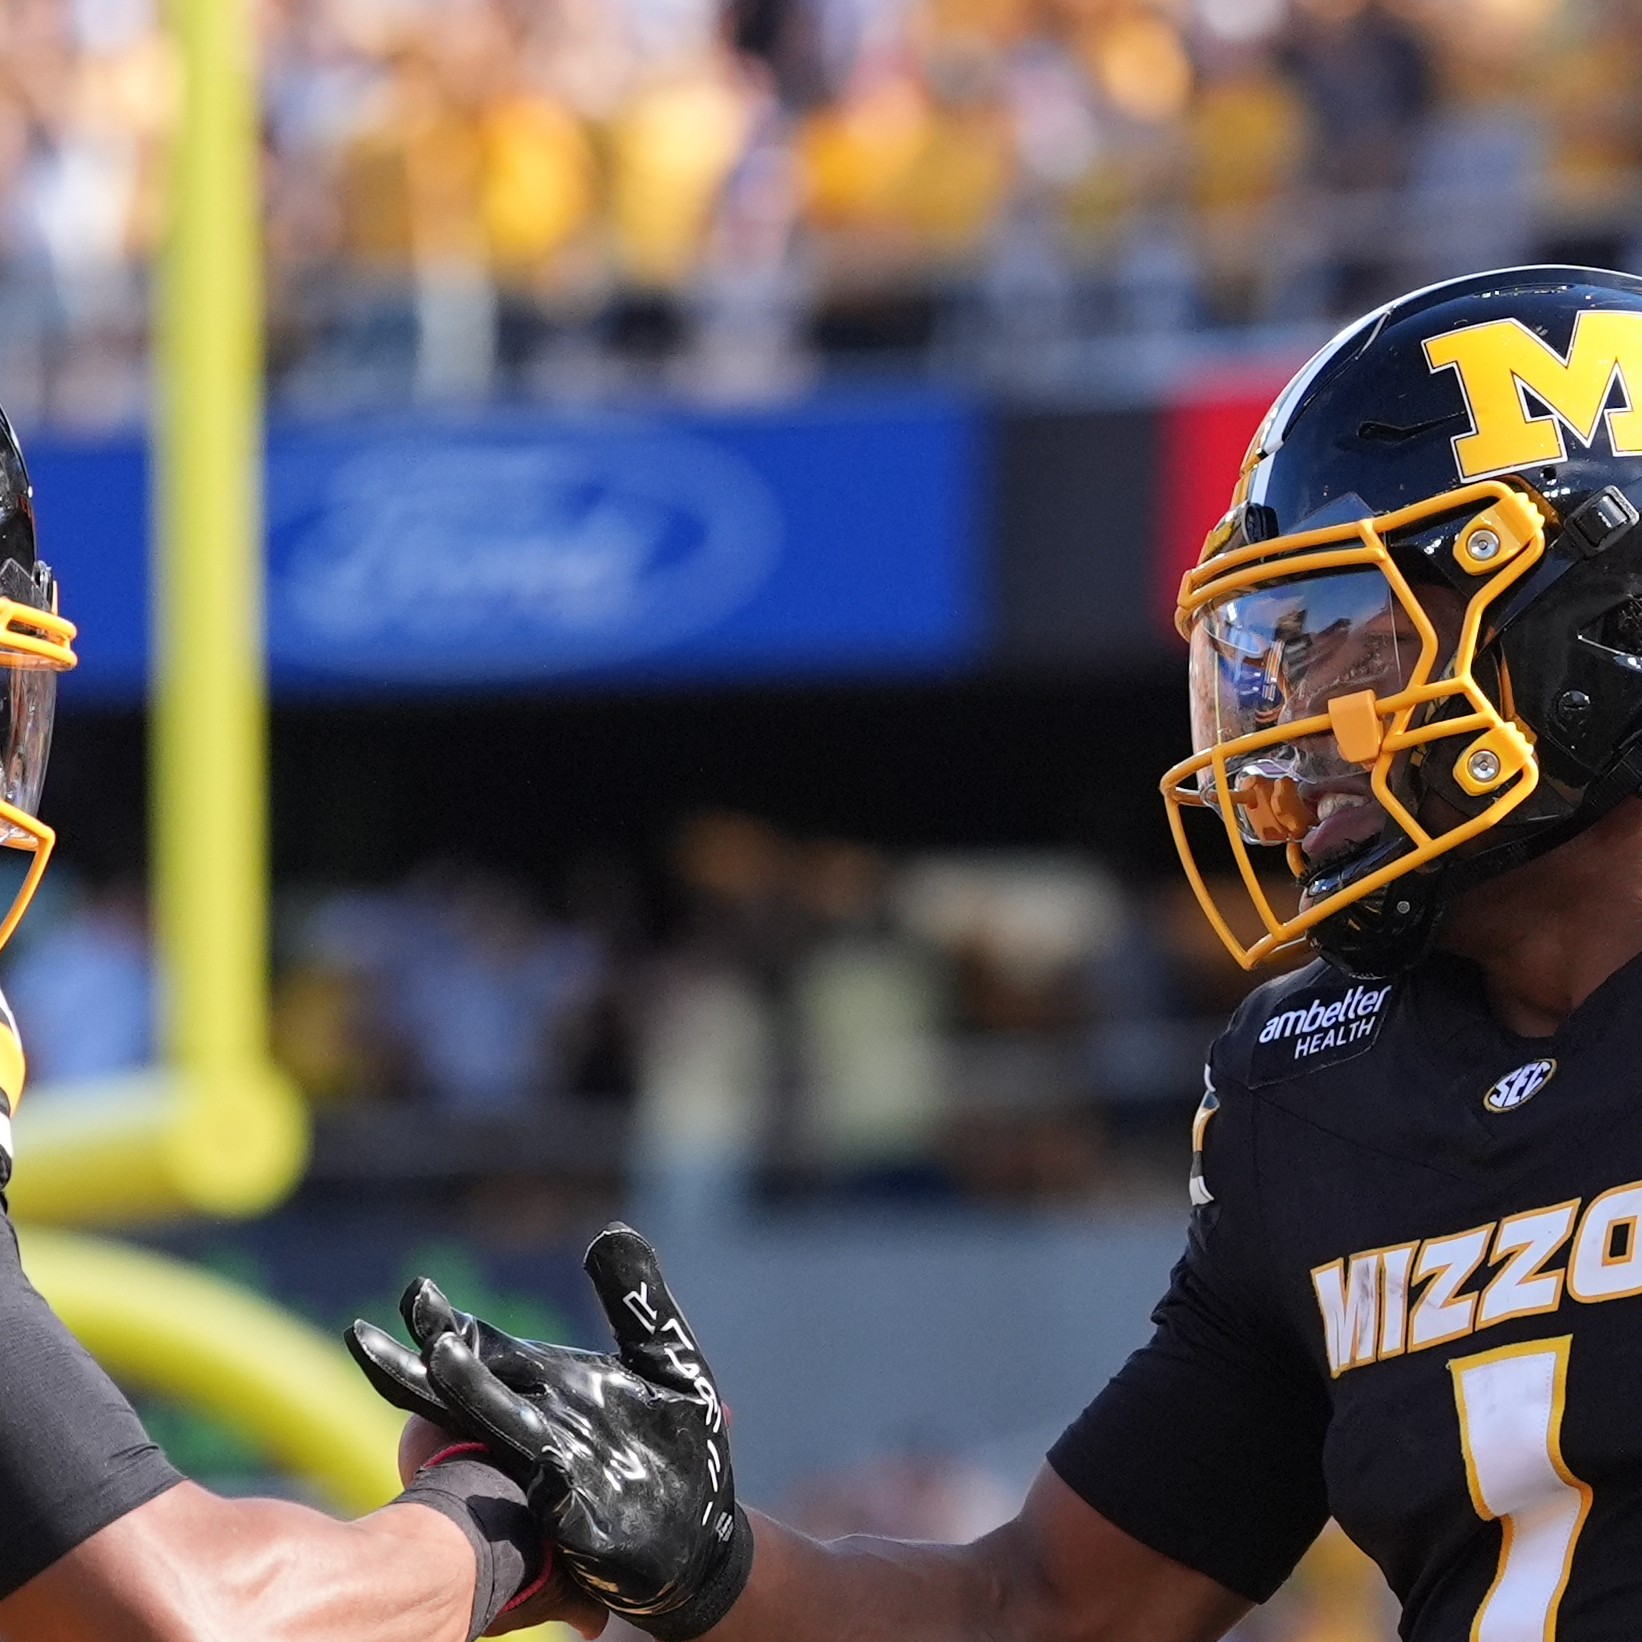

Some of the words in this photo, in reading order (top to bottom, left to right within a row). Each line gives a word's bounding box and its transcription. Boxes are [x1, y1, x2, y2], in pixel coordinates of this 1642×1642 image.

[1259, 984, 1392, 1044] ambetter
[1294, 1016, 1376, 1060] HEALTH
[1488, 1060, 1553, 1108] SEC
